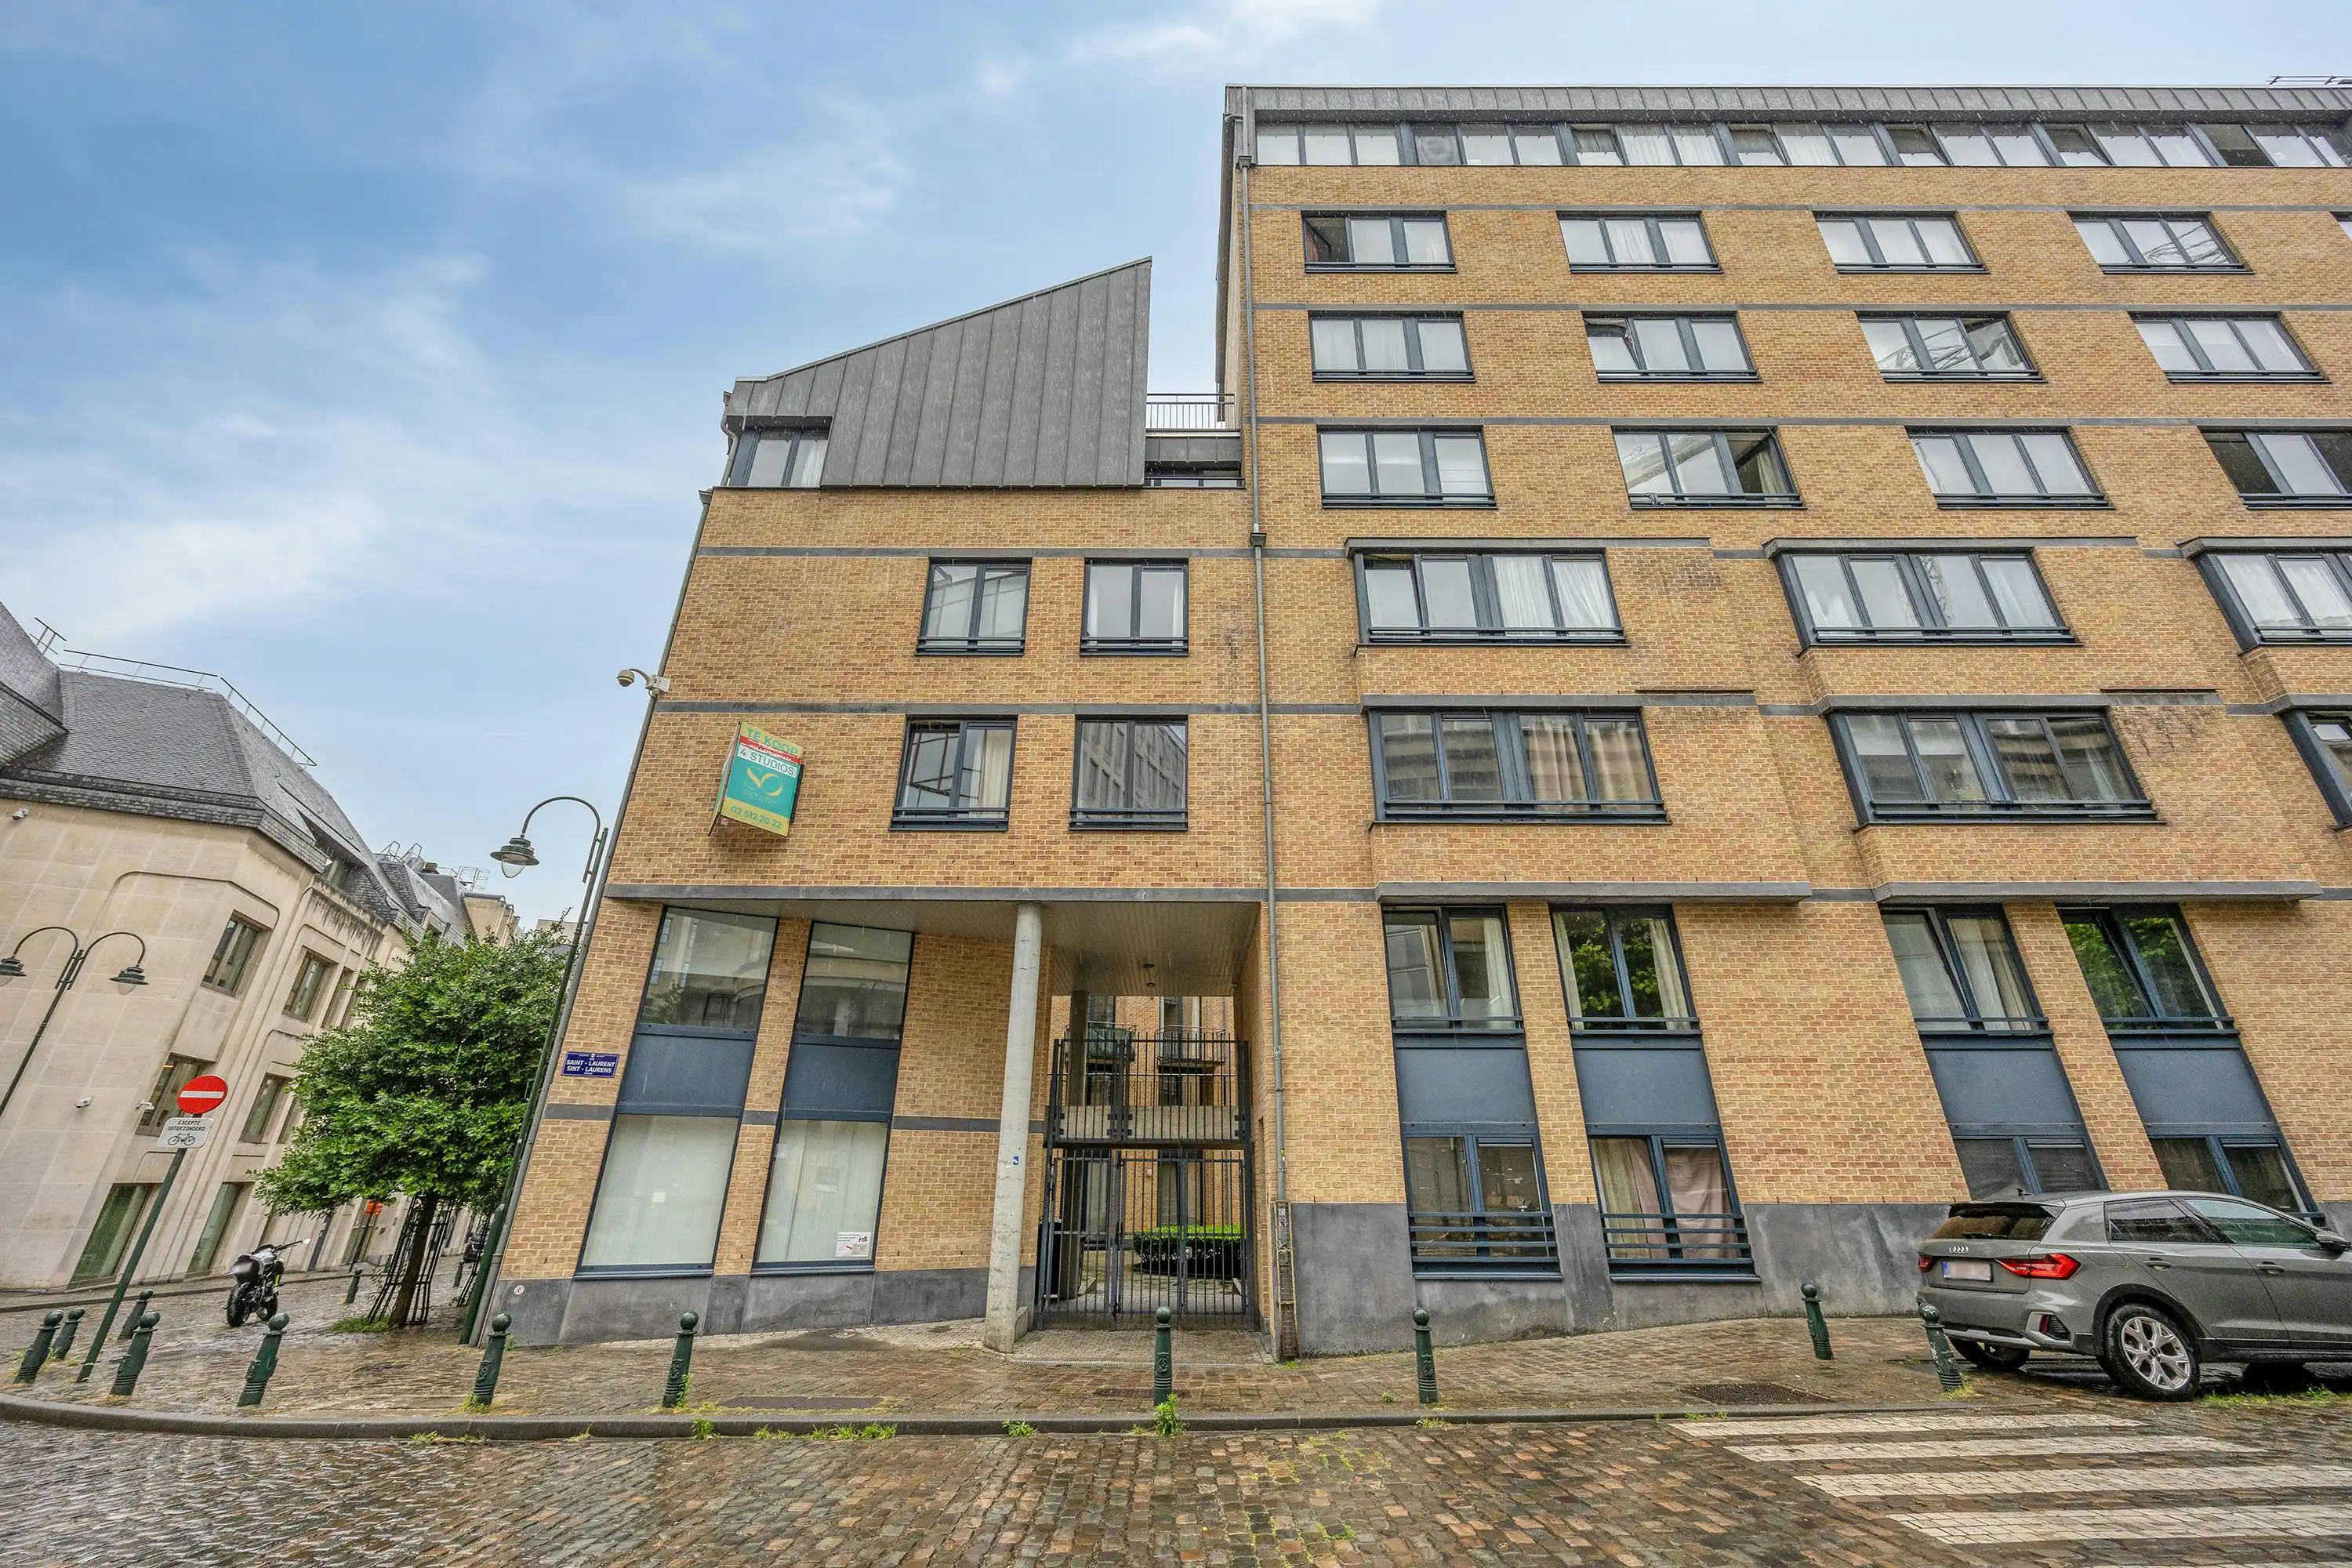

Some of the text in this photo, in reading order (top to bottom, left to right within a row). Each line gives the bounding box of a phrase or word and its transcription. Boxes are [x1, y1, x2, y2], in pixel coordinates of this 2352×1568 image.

[747, 728, 760, 740] TE
[764, 735, 797, 754] KOOP
[750, 751, 795, 775] STUDIOS
[731, 805, 742, 815] 02
[744, 810, 758, 822] 512
